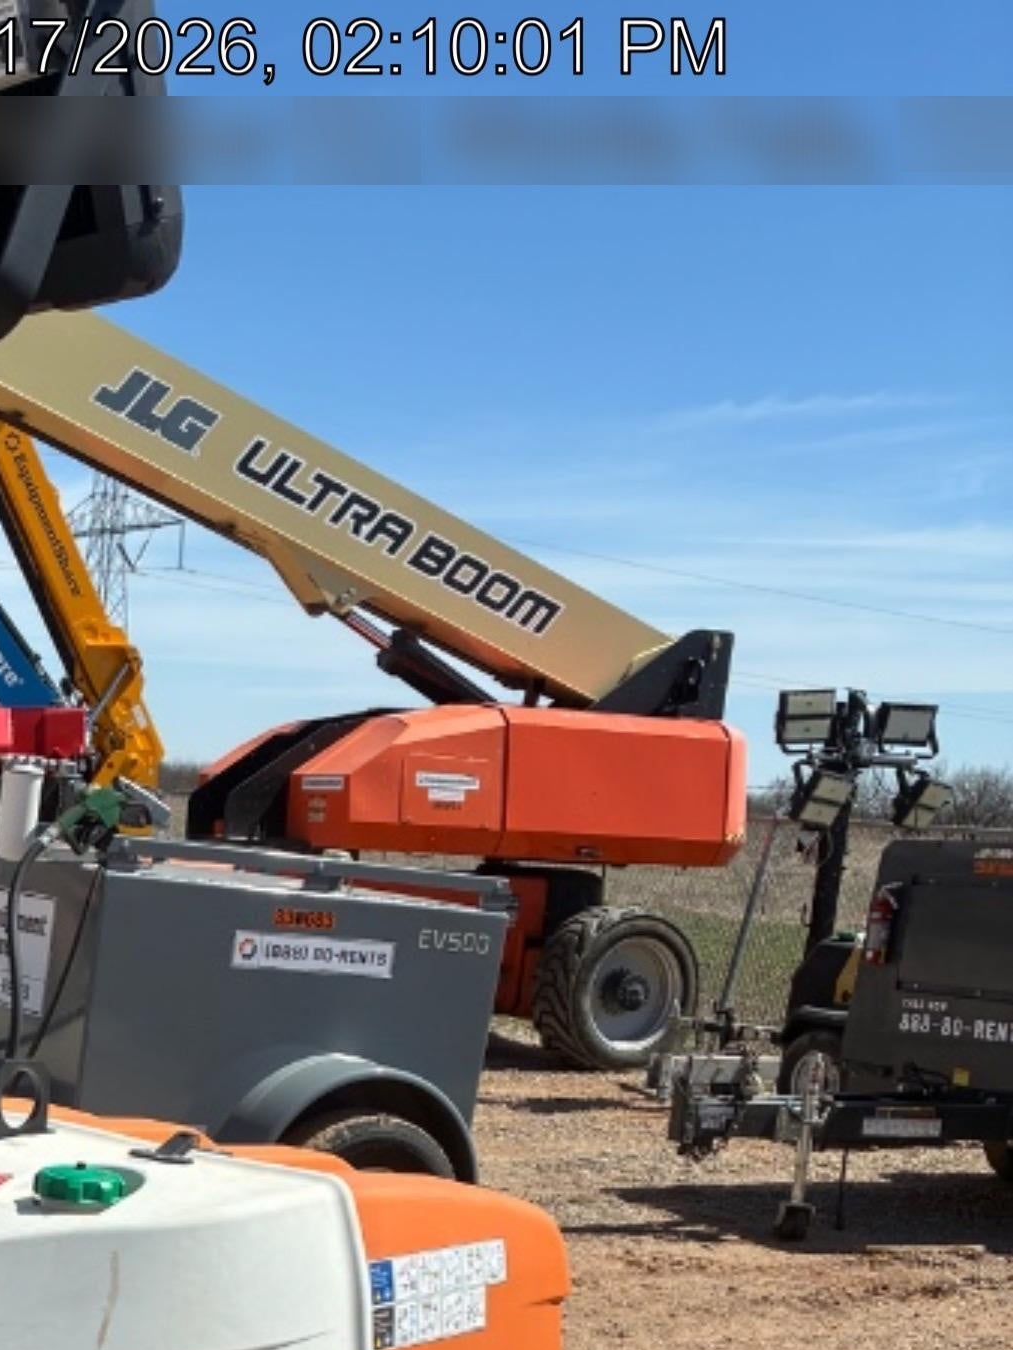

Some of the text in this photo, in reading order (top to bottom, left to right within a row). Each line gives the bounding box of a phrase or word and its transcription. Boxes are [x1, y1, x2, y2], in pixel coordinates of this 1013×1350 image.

[93, 367, 220, 452] JLG
[235, 437, 563, 634] ULTRA BOOM
[419, 929, 490, 954] EV500
